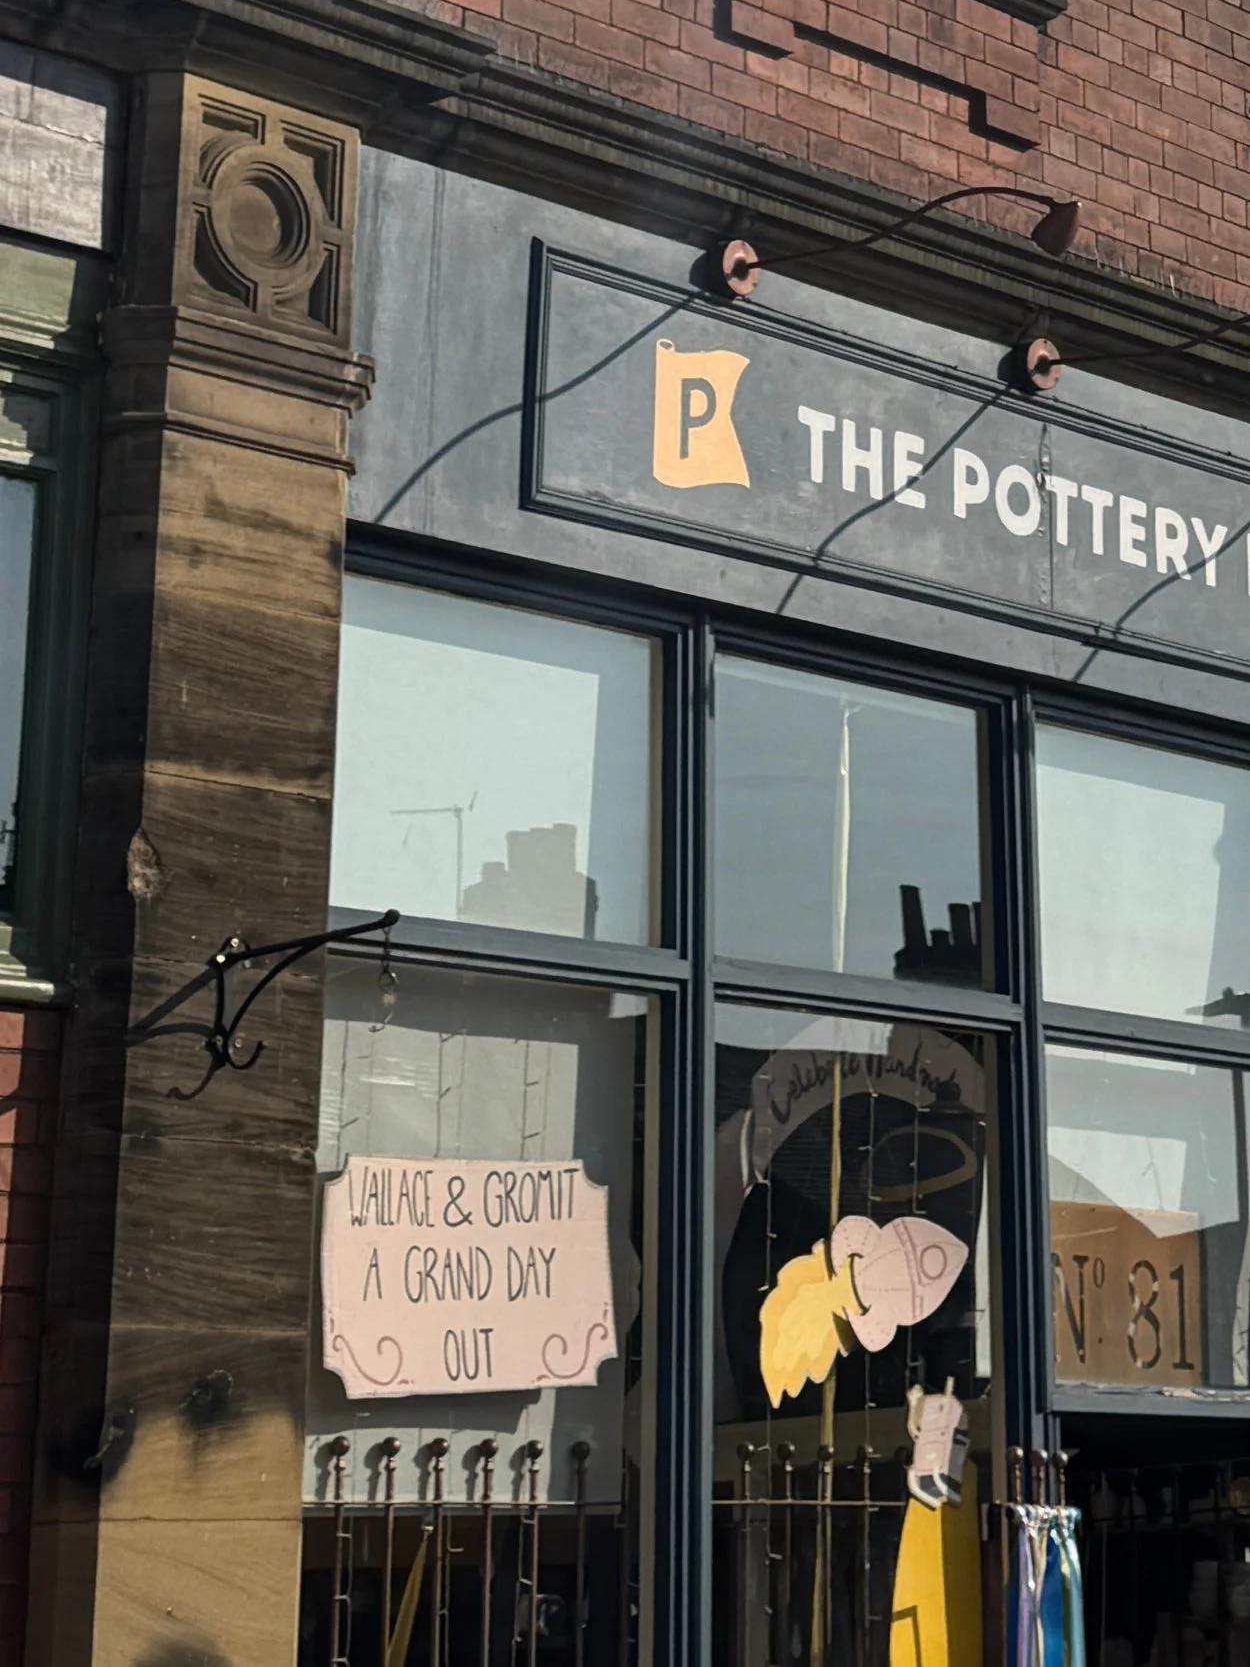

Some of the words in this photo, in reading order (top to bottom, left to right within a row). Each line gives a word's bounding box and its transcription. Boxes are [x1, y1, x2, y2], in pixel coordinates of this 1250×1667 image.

[679, 377, 717, 461] P
[797, 404, 926, 510] THE
[953, 447, 1229, 587] POTTERY
[349, 1166, 435, 1227] WALLACE
[443, 1175, 473, 1227] &
[484, 1168, 580, 1228] GROMIT
[363, 1247, 383, 1301] A
[404, 1245, 493, 1303] GRAND
[507, 1246, 556, 1302] DAY
[1128, 1259, 1195, 1370] 81
[443, 1328, 494, 1381] OUT
